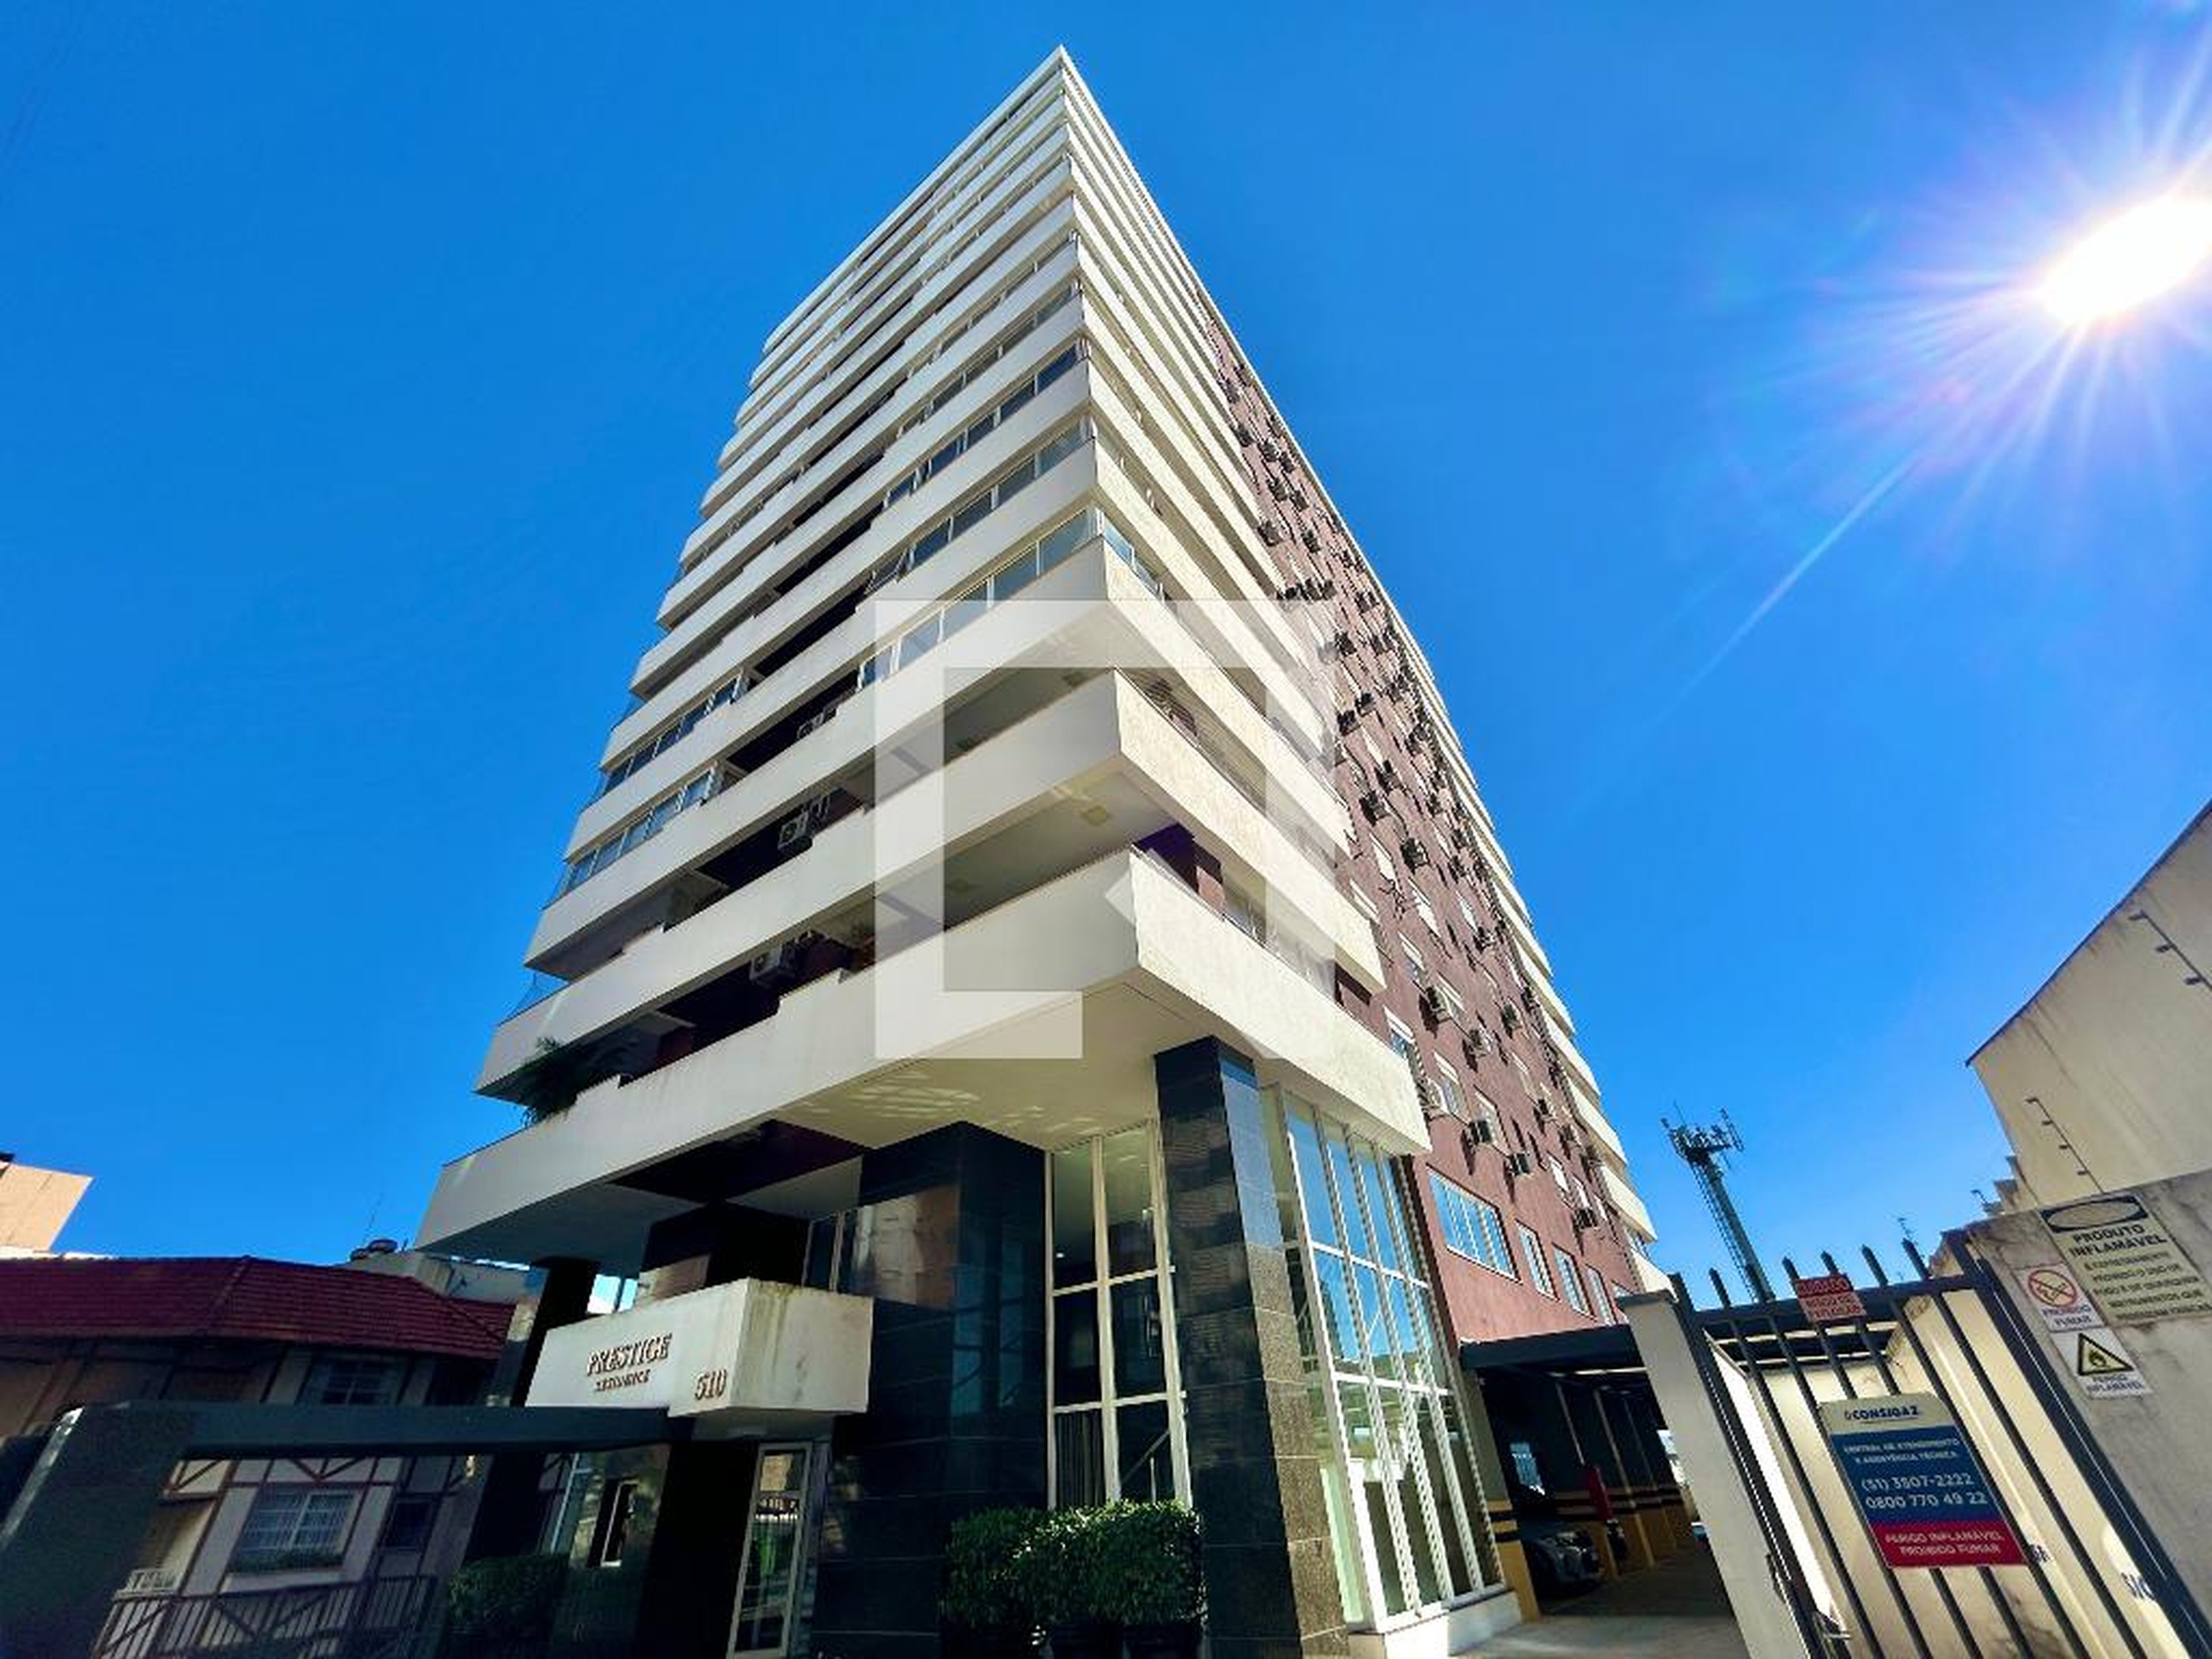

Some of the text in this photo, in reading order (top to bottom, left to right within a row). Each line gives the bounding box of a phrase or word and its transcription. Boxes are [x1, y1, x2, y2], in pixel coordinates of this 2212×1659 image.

[2073, 1224, 2145, 1243] PRODUTO
[2070, 1234, 2167, 1256] INFLAMÁVEL
[586, 1333, 673, 1377] PRESTIGE
[695, 1369, 727, 1400] 510
[1866, 1496, 1906, 1509] 0800
[1909, 1494, 1939, 1506] 770
[1965, 1490, 1987, 1505] 22
